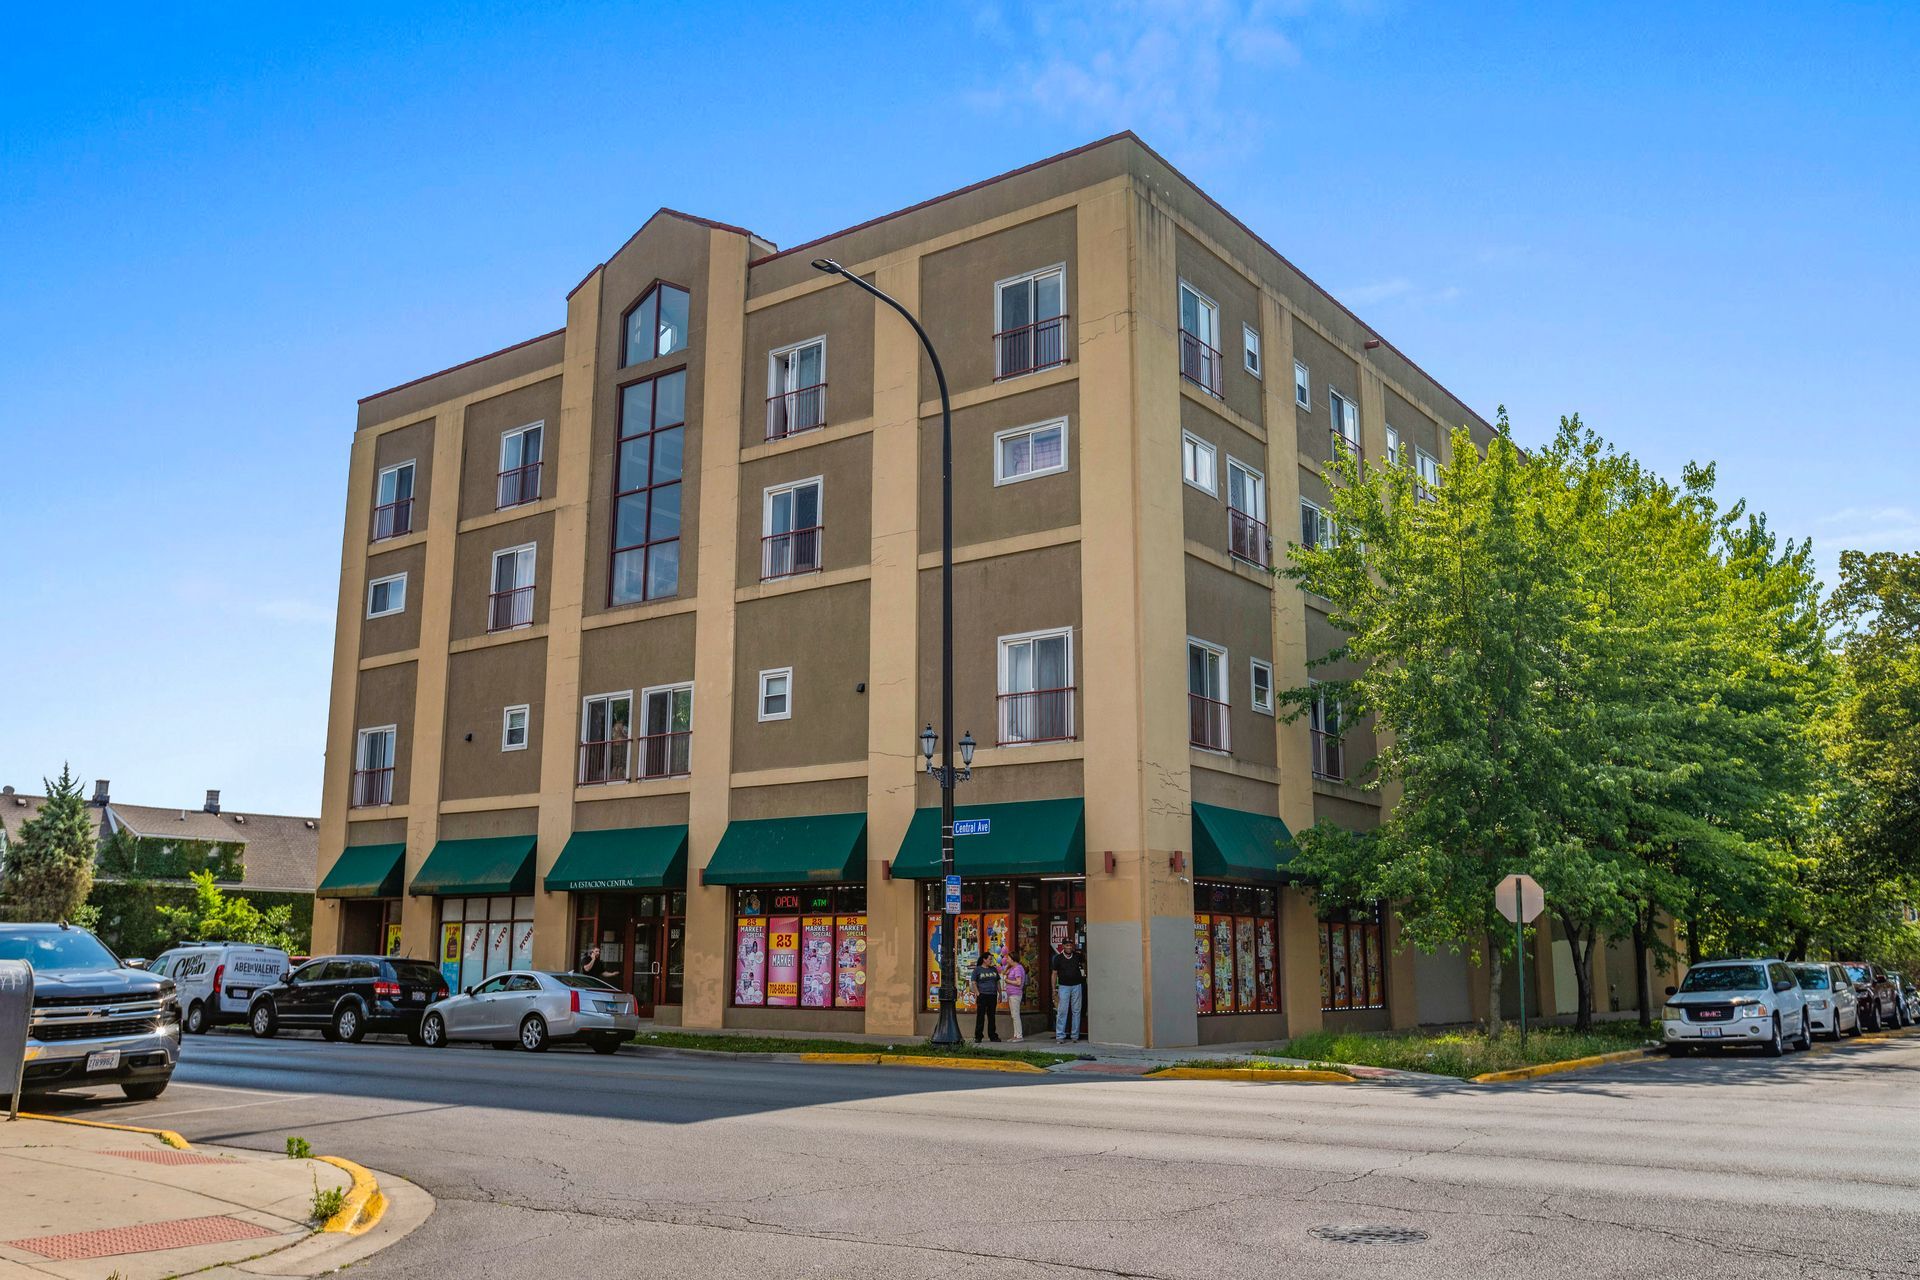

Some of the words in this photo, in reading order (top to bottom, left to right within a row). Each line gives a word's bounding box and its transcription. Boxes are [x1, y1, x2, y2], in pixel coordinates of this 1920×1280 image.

[956, 822, 976, 834] Central
[978, 821, 989, 832] Ave
[776, 895, 798, 907] OPEN
[813, 898, 827, 907] ATM
[1053, 925, 1069, 938] ATM
[471, 926, 484, 951] SPARK
[495, 926, 508, 951] AUTO
[777, 934, 793, 948] 23
[773, 954, 795, 967] MARKET
[235, 961, 252, 972] ABEL
[255, 962, 280, 975] VALENTE
